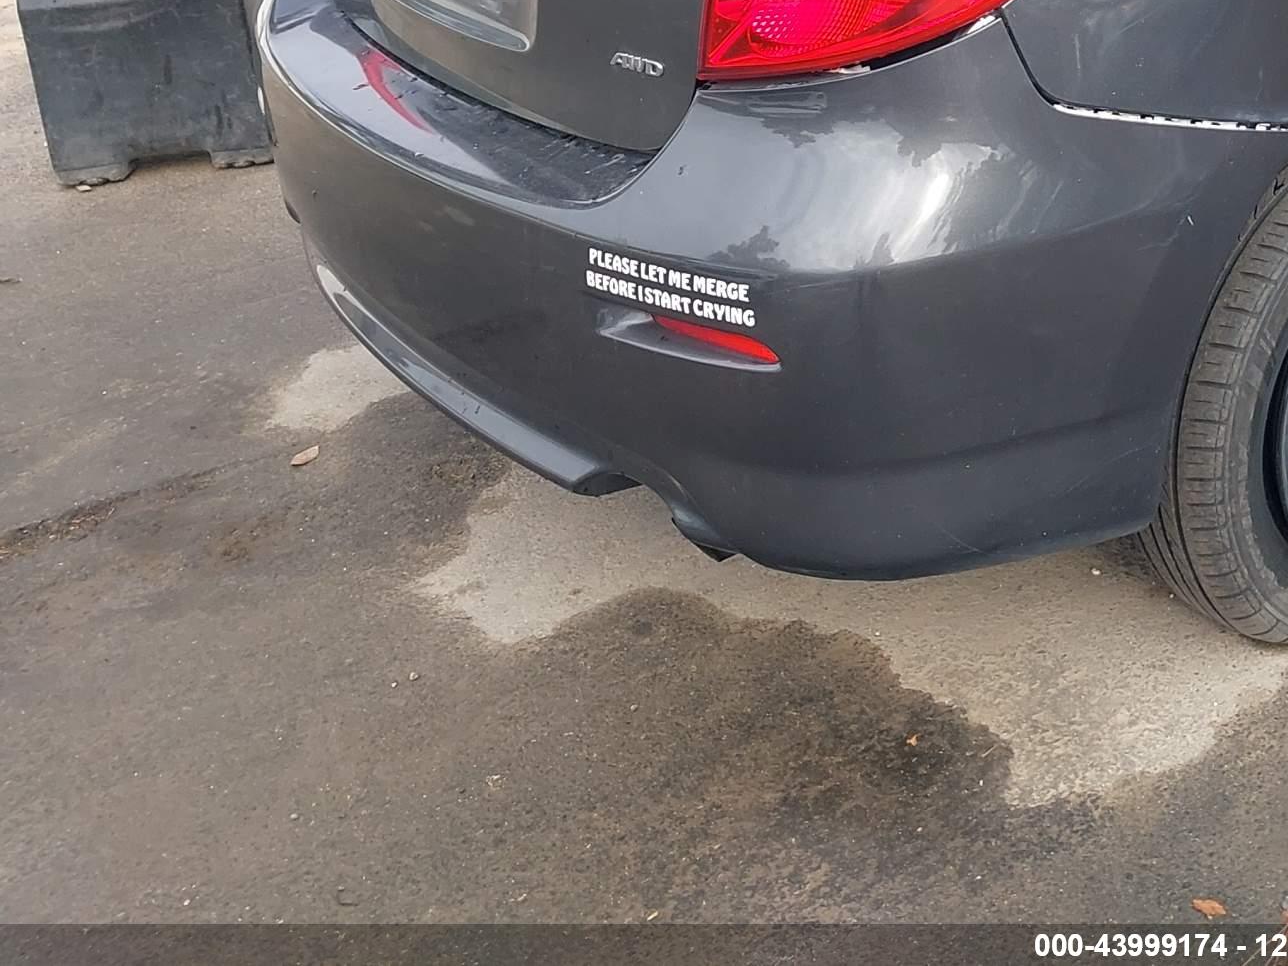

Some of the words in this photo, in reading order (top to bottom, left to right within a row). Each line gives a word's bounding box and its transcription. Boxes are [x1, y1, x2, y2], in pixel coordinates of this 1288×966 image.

[610, 52, 664, 78] AWD
[586, 270, 637, 301] BEFORE
[638, 285, 644, 302] I
[644, 287, 693, 315] START
[693, 299, 756, 327] CRYING
[589, 247, 640, 278] PLEASE
[640, 262, 667, 284] LET
[668, 269, 692, 291] ME
[693, 275, 750, 303] MERGE
